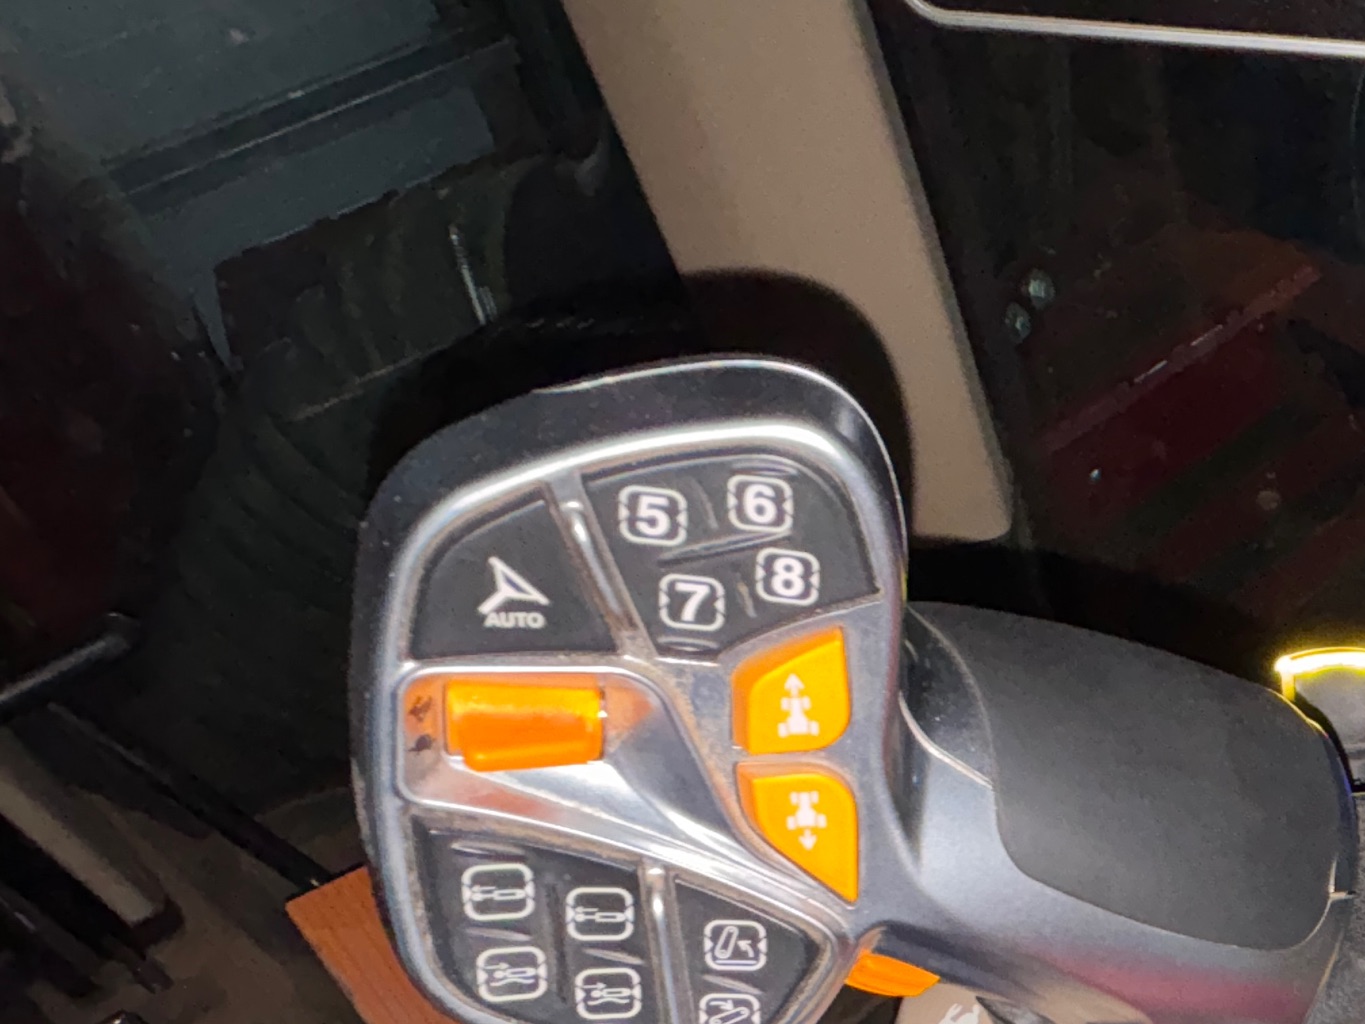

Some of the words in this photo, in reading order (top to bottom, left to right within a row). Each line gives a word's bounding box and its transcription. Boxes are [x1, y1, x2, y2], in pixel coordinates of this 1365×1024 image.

[635, 494, 670, 537] 5
[743, 483, 777, 525] 6
[771, 556, 805, 598] 8
[483, 610, 546, 629] AUTO
[674, 581, 711, 622] 7
